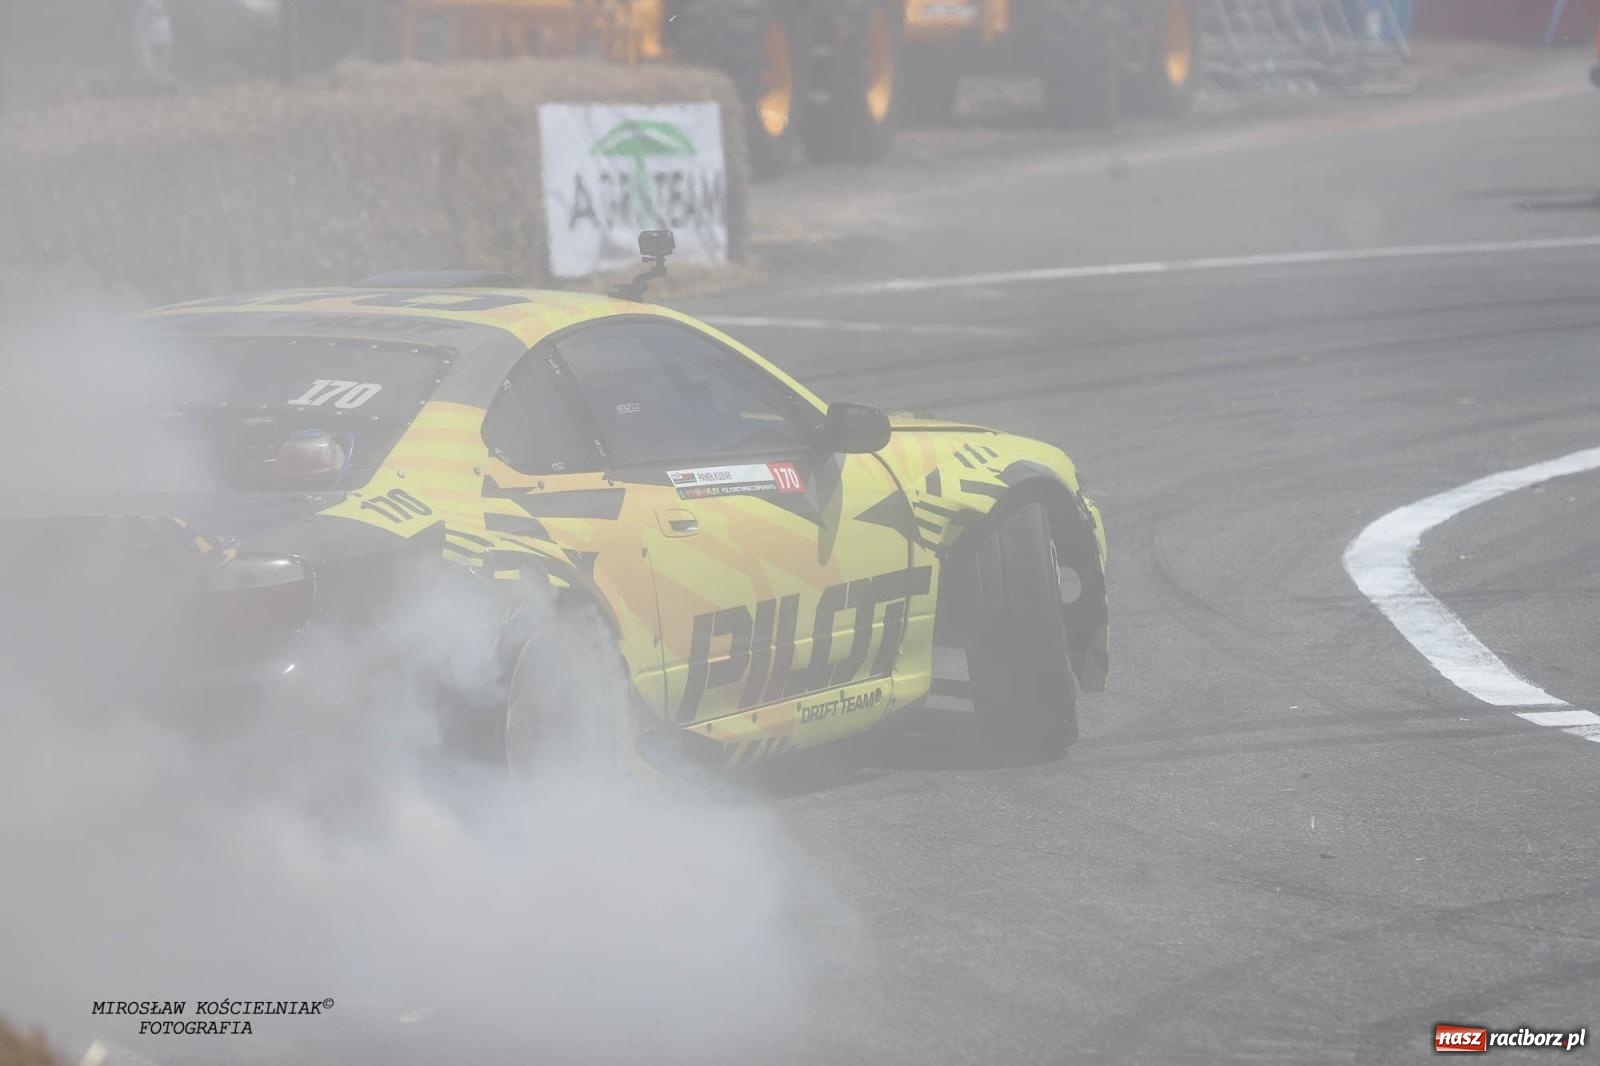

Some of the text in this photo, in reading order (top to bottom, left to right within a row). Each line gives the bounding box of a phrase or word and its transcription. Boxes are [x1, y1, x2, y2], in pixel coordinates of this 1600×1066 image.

[288, 379, 383, 409] 170
[774, 467, 800, 488] 170
[360, 488, 433, 523] 170
[675, 565, 932, 724] PILOT
[800, 692, 875, 724] DRIFT TEAM
